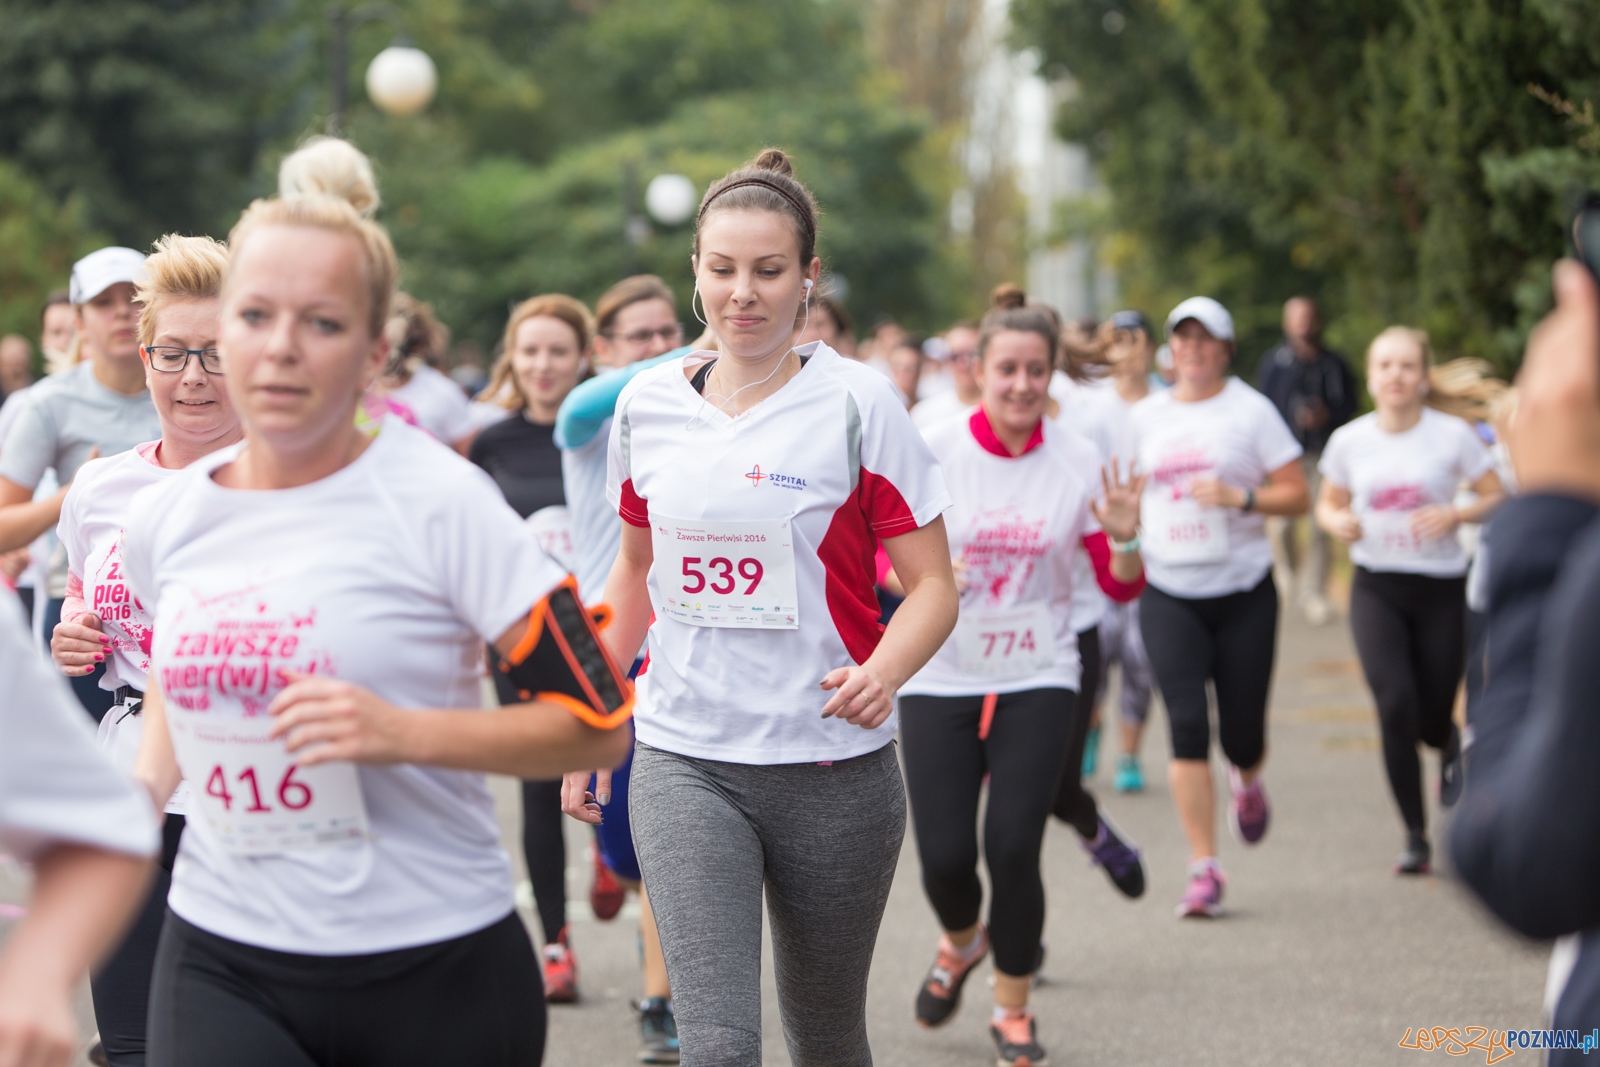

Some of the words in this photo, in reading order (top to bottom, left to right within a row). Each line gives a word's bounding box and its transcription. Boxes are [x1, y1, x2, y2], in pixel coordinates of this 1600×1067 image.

[769, 473, 807, 487] SZPITAL
[676, 531, 705, 542] Zawsze
[707, 533, 742, 543] Pier(w)si
[744, 534, 767, 543] 2016
[682, 556, 764, 595] 539
[100, 604, 131, 621] 2016
[174, 632, 299, 659] zawsze
[981, 628, 1036, 658] 774
[205, 764, 313, 812] 416
